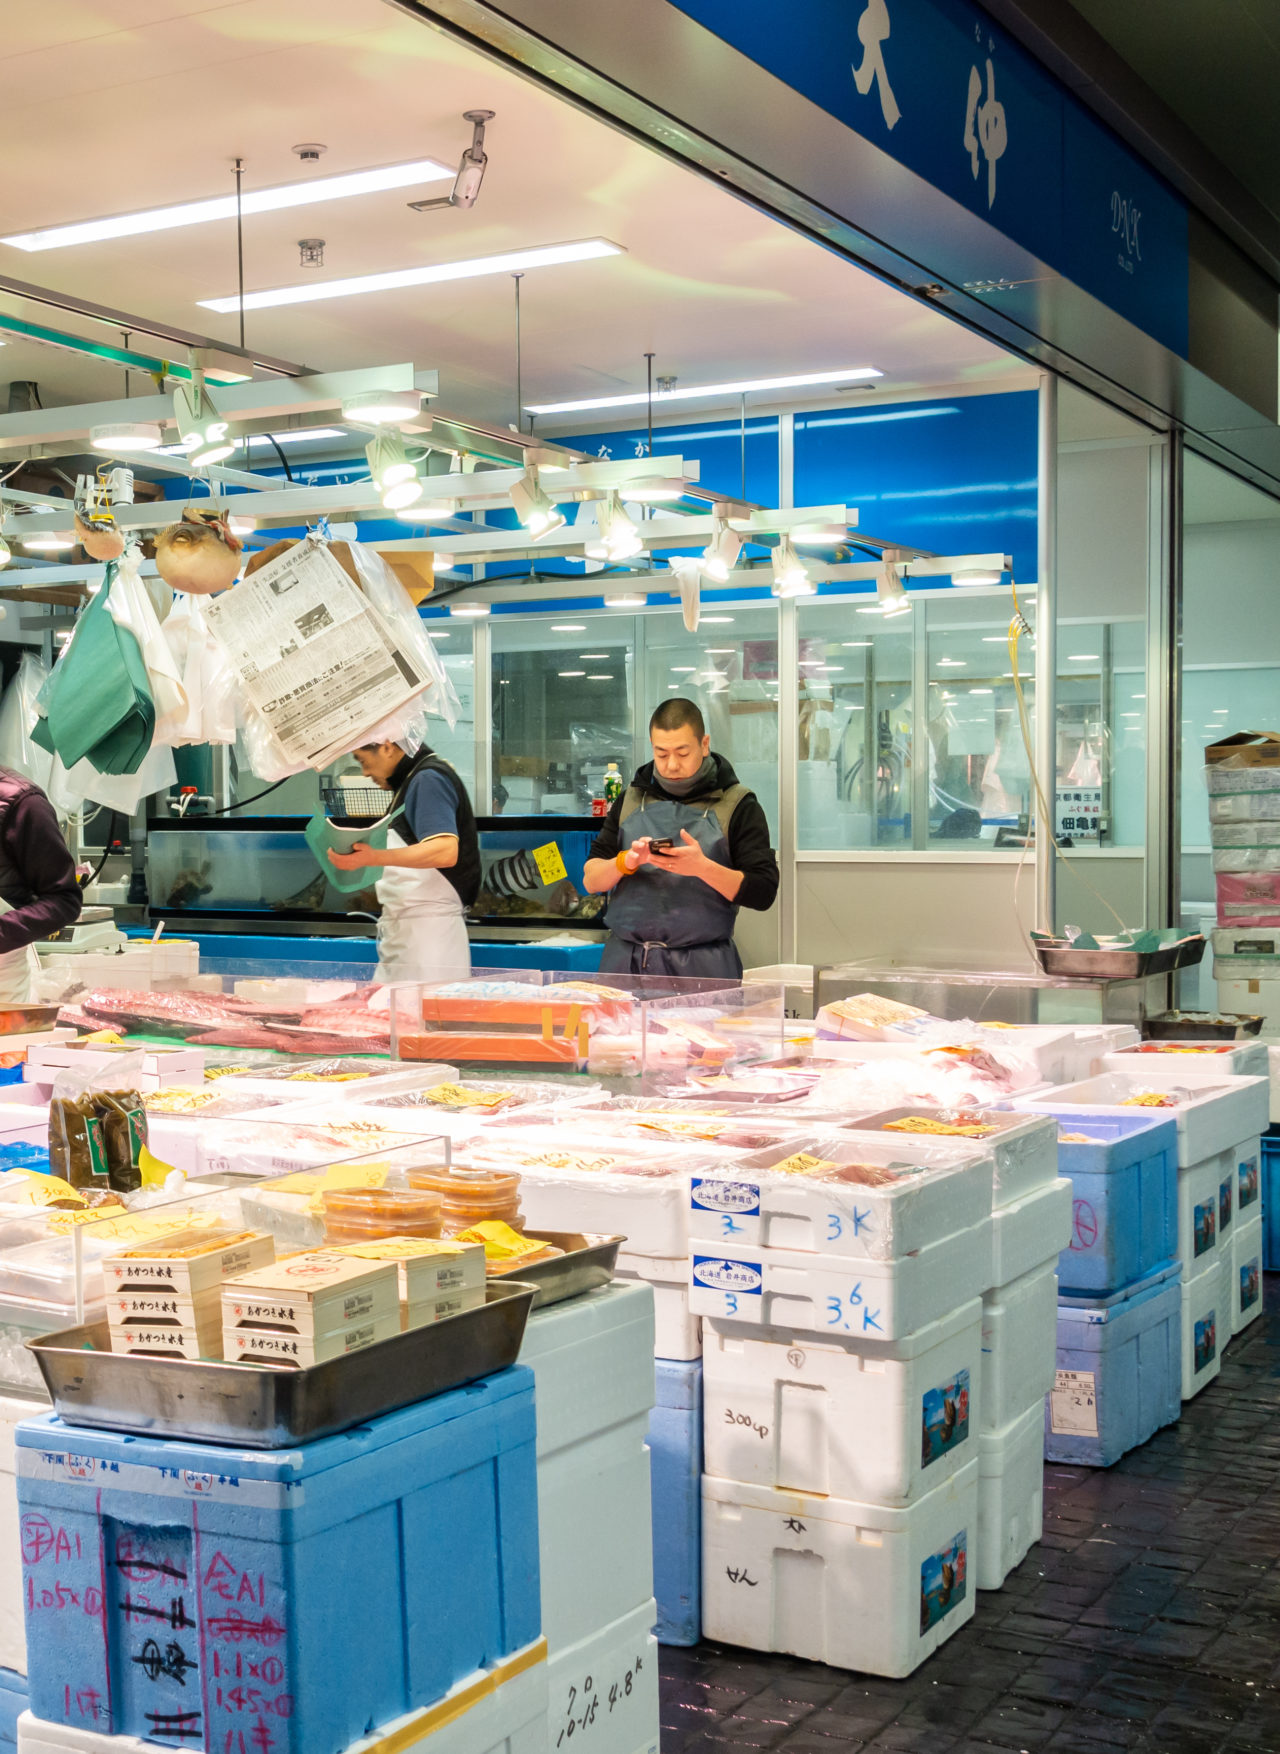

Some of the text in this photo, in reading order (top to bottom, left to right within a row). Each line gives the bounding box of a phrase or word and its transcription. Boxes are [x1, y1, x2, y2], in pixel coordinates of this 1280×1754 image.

[1111, 191, 1142, 261] DNK
[127, 1266, 173, 1278] あかつき水産
[132, 1300, 178, 1313] あかつき水産
[725, 1293, 738, 1317] 3
[247, 1306, 296, 1320] あかつき水産
[138, 1333, 185, 1346] あかつき水産
[250, 1338, 299, 1355] あかつき水産
